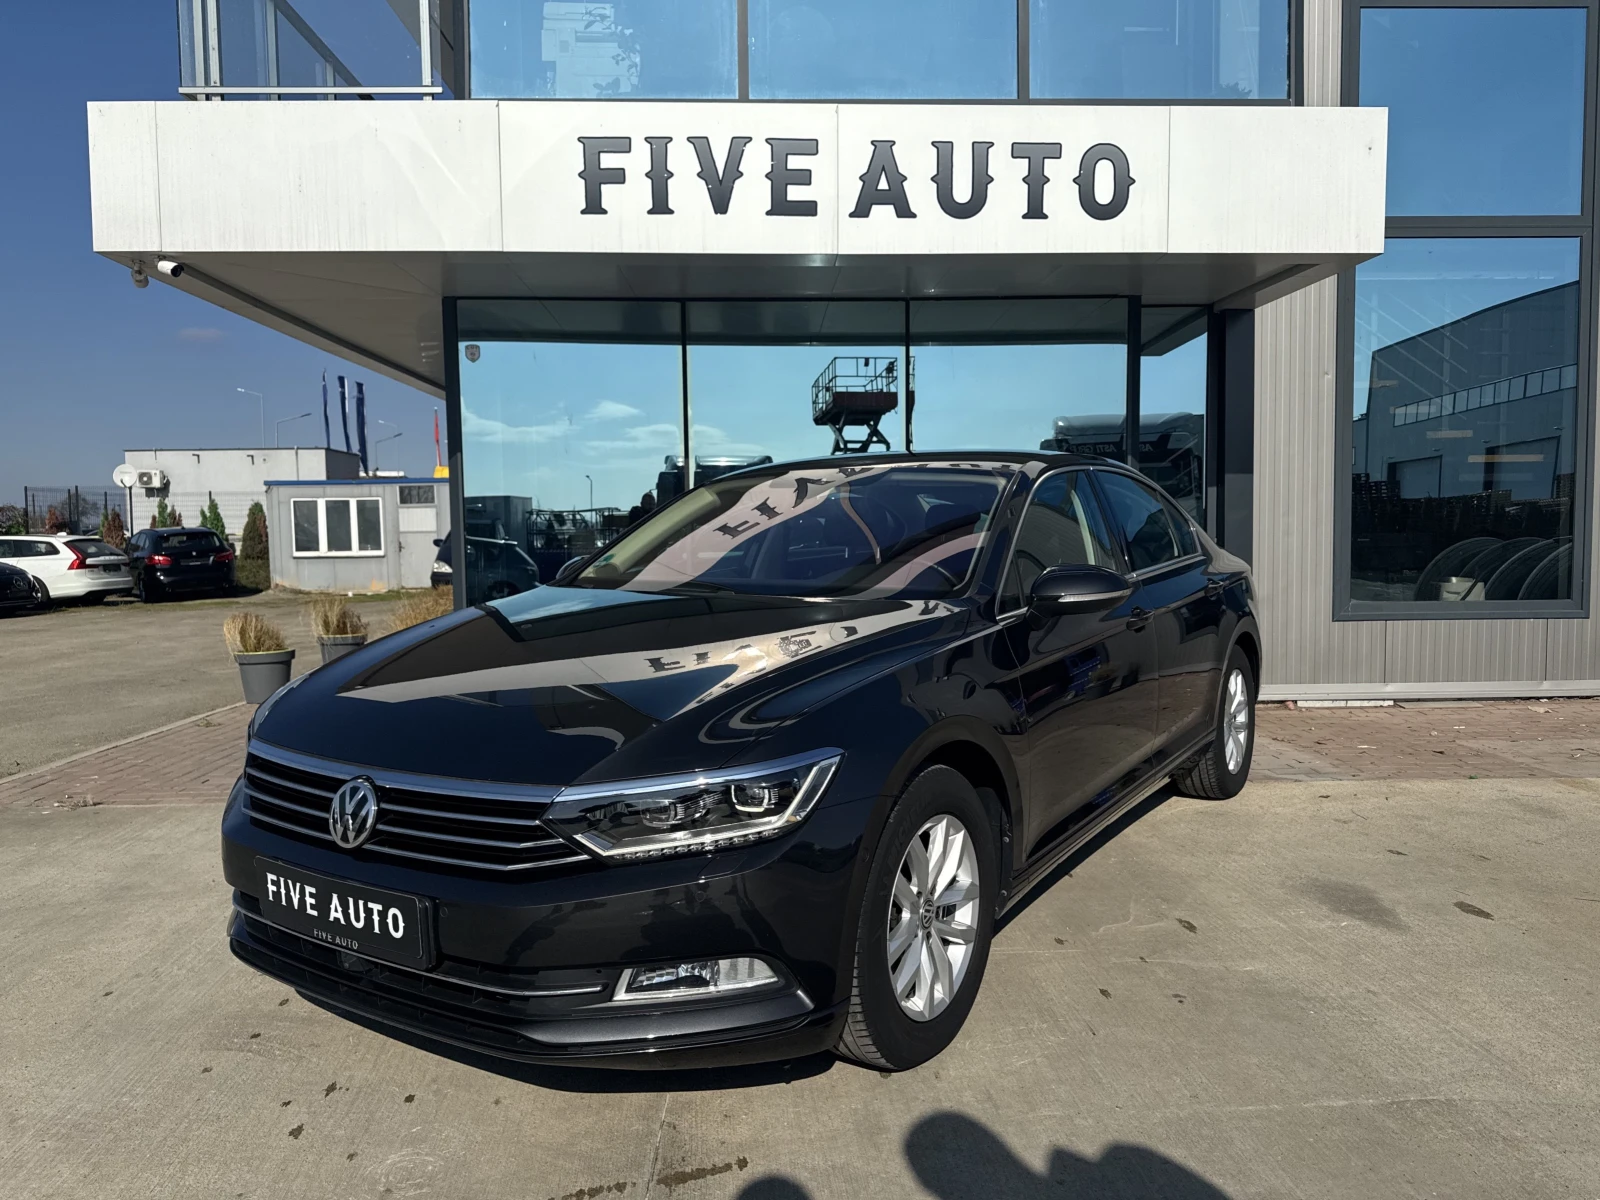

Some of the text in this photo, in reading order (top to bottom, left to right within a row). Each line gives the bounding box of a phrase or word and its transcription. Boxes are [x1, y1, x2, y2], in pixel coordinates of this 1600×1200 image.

[577, 136, 1136, 219] FIVE AUTO
[329, 777, 377, 849] VW
[266, 872, 405, 939] FIVE AUTO
[313, 928, 359, 950] FIVE AUTO
